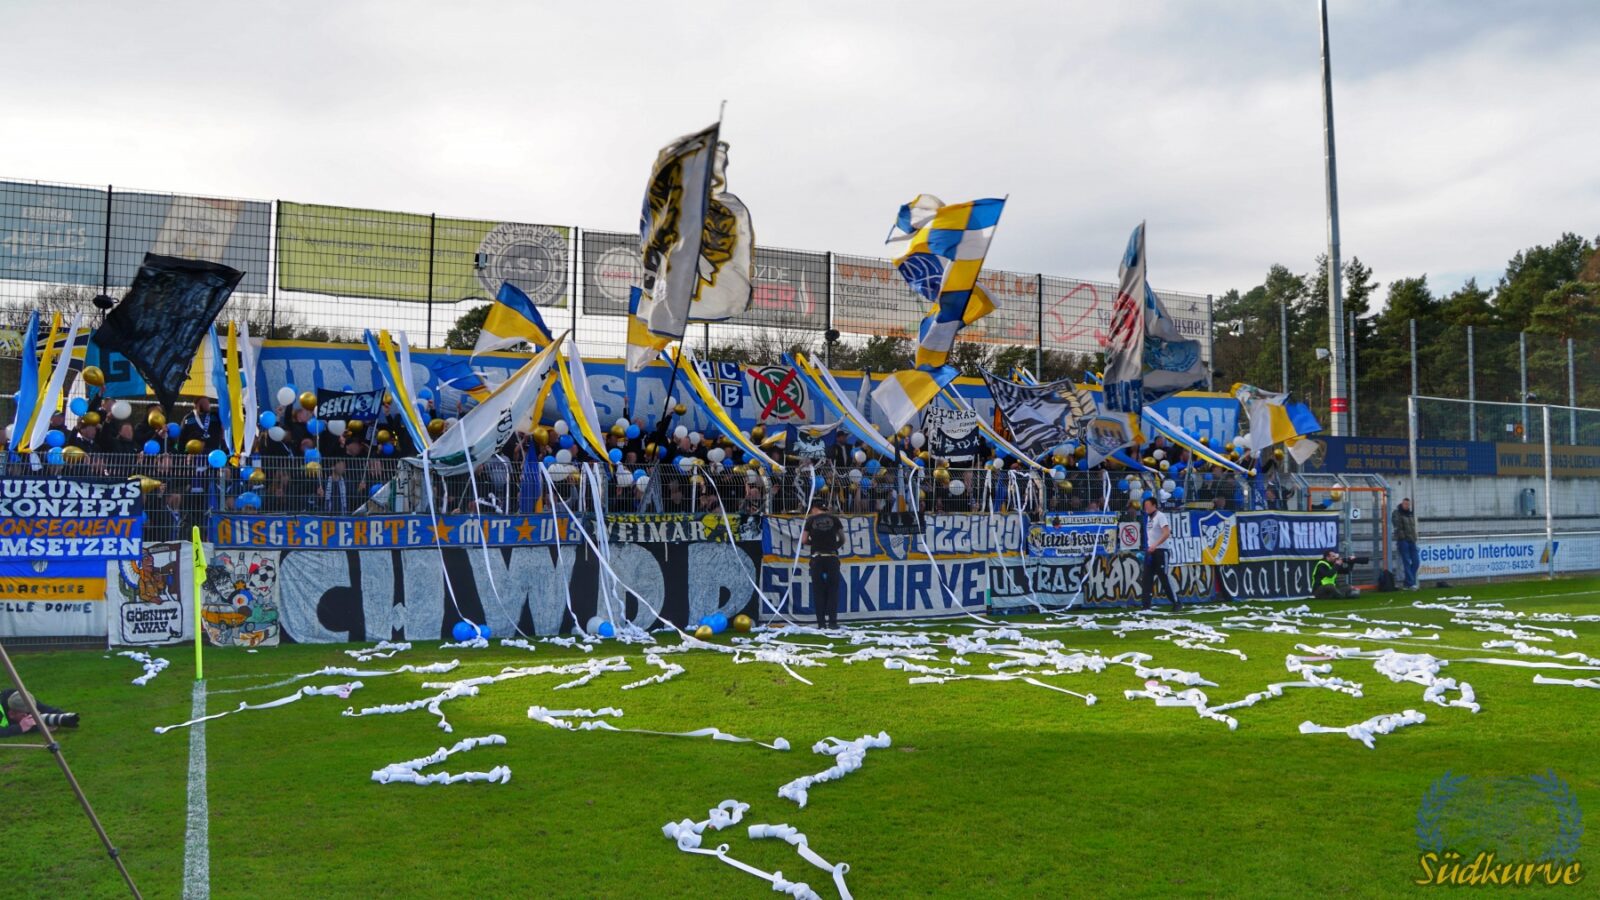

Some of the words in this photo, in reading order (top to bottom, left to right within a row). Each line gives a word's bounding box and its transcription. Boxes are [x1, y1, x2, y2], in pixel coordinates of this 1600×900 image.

[0, 480, 140, 499] UKUNFTS
[1352, 508, 1359, 519] C
[0, 518, 136, 538] ONSEQUENT
[217, 516, 422, 546] AUSGESPERRTE
[458, 515, 510, 543] MIT
[540, 516, 581, 542] UNS
[1292, 521, 1337, 550] MIND
[0, 538, 140, 556] MSETZEN
[1419, 545, 1475, 562] eisebüro
[1478, 543, 1534, 559] Intertours
[761, 560, 986, 616] SÜKURVE
[992, 565, 1081, 596] ULTRAS
[1220, 560, 1314, 598] Saalfel
[45, 602, 92, 613] DONNE
[132, 621, 169, 634] AWAY
